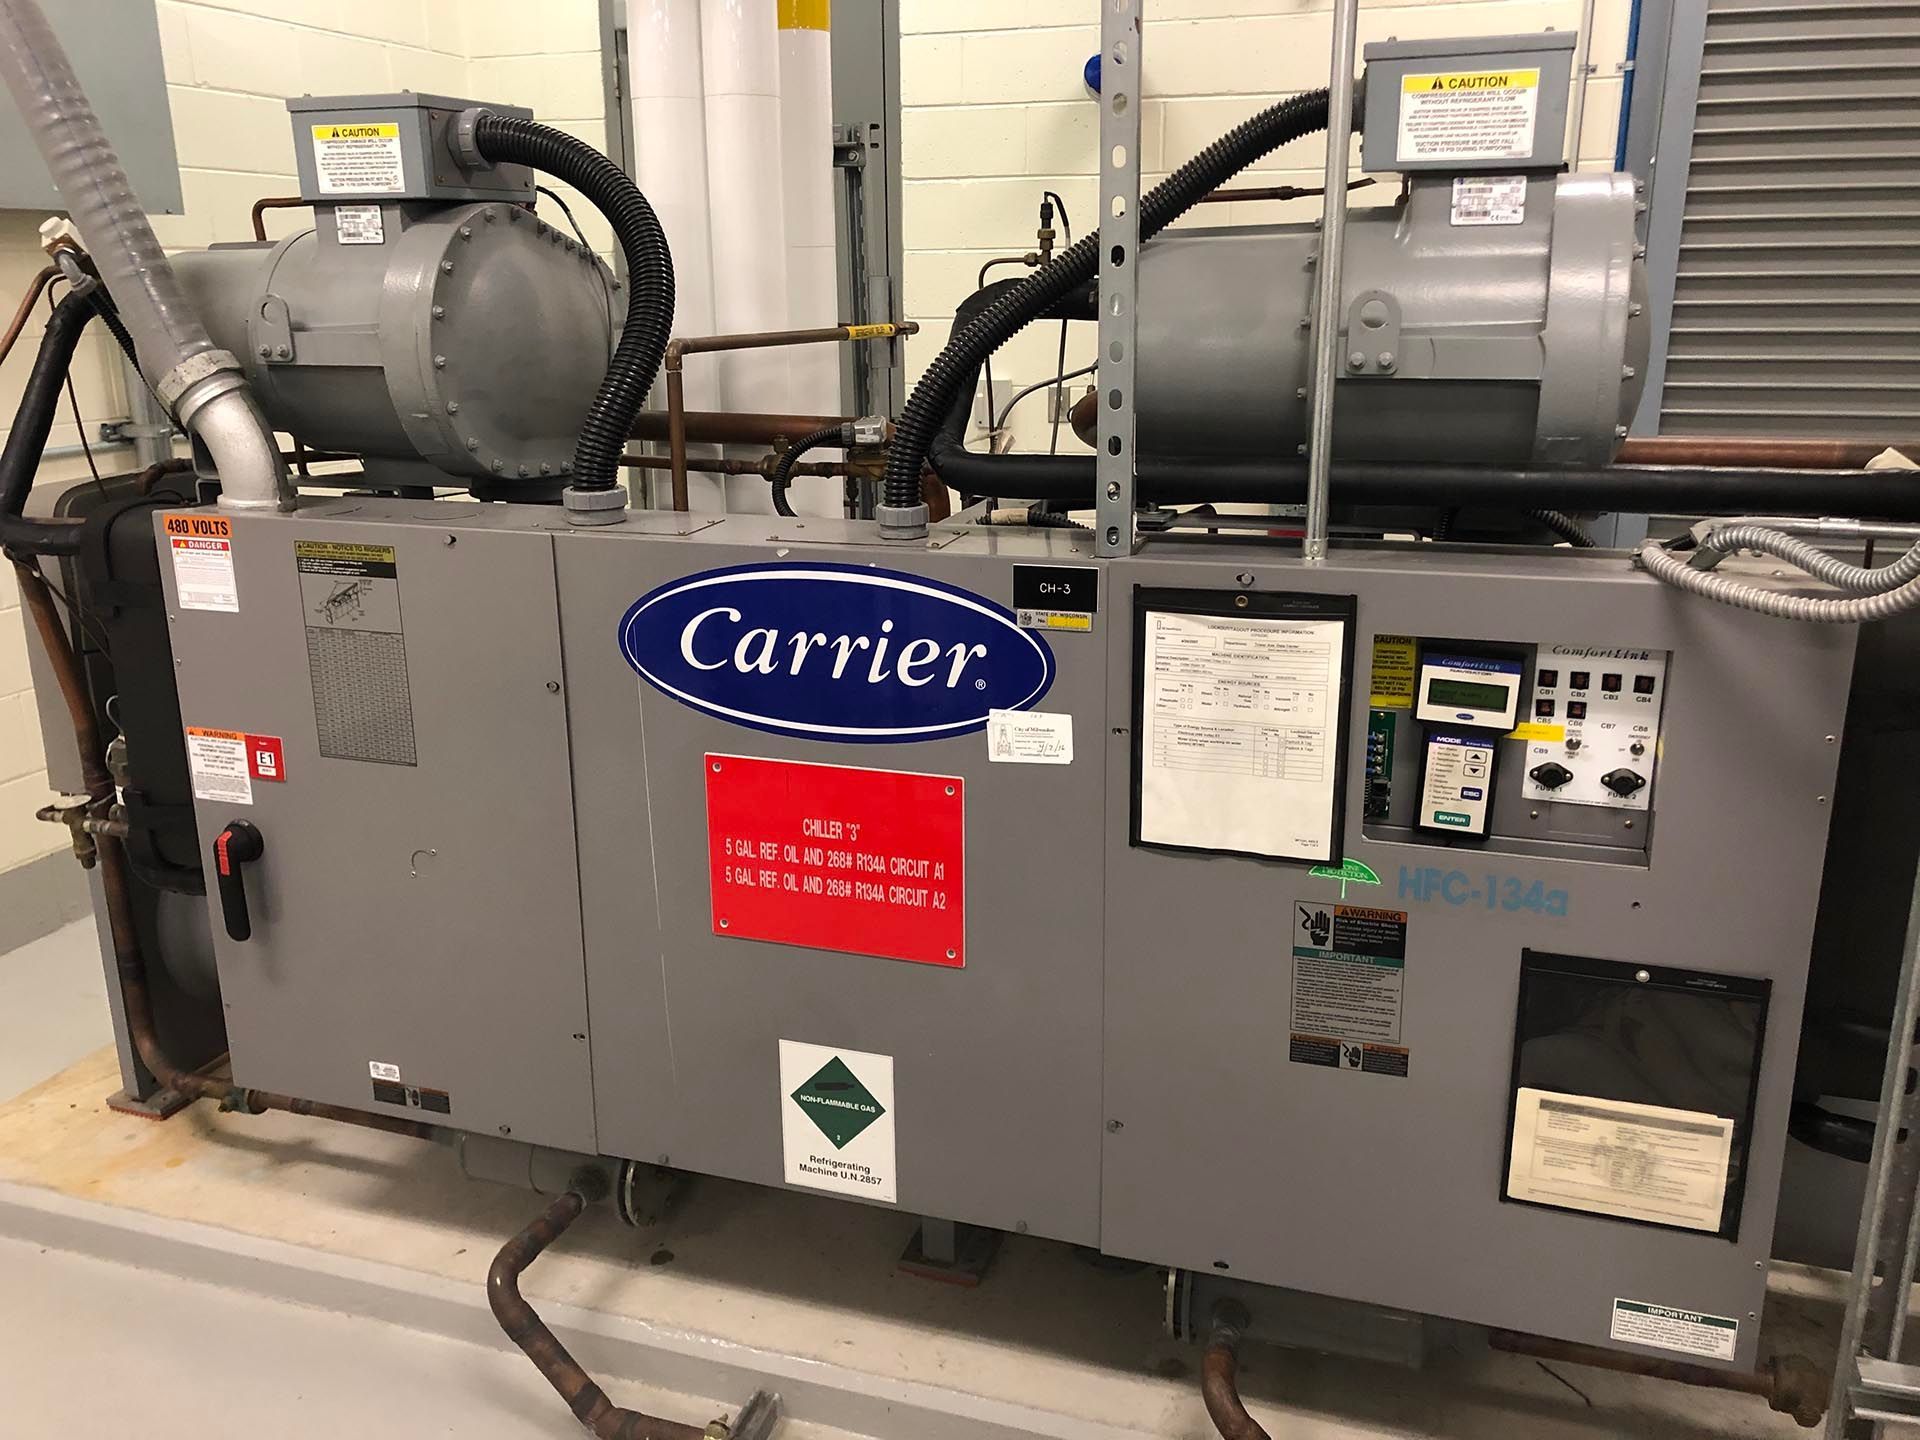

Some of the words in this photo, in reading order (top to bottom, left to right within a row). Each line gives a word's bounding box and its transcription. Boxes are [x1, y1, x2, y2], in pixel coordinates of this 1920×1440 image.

[1448, 76, 1508, 89] CAUTION
[342, 128, 380, 137] CAUTION
[168, 519, 189, 534] 480
[192, 520, 228, 536] VOLTS
[188, 541, 223, 550] DANGER
[1040, 582, 1071, 594] CH-3
[680, 607, 987, 689] Carrier
[1374, 636, 1411, 645] CAUTION
[1552, 645, 1650, 660] ComfortLink
[1442, 658, 1501, 670] ComfortLink
[202, 730, 237, 740] WARNING
[260, 752, 272, 764] E1
[803, 818, 842, 839] CHILLER
[846, 822, 860, 841] "3"
[726, 838, 732, 855] 5
[736, 840, 757, 858] GAL.
[760, 842, 781, 861] REF.
[784, 845, 799, 864] OIL
[803, 848, 824, 866] AND
[827, 851, 852, 869] 268#
[856, 856, 886, 874] R134A
[890, 857, 929, 879] CIRCUIT
[934, 862, 944, 880] A1
[725, 866, 732, 883] 5
[735, 868, 756, 886] GAL.
[760, 870, 780, 889] REF.
[784, 873, 799, 892] OIL
[803, 876, 823, 895] AND
[827, 879, 851, 897] 268#
[856, 883, 885, 902] R134A
[889, 886, 928, 907] CIRCUIT
[932, 892, 946, 910] A2
[1400, 865, 1568, 916] HFC-134a
[1350, 908, 1401, 920] WARNING
[1319, 951, 1376, 963] IMPORTANT
[800, 1094, 859, 1111] NON-FLAMMABLE
[860, 1104, 875, 1113] GAS
[810, 1155, 871, 1174] Refrigerating
[799, 1164, 838, 1177] Machine
[840, 1171, 882, 1186] U.N.2857
[1648, 1307, 1703, 1323] IMPORTANT
